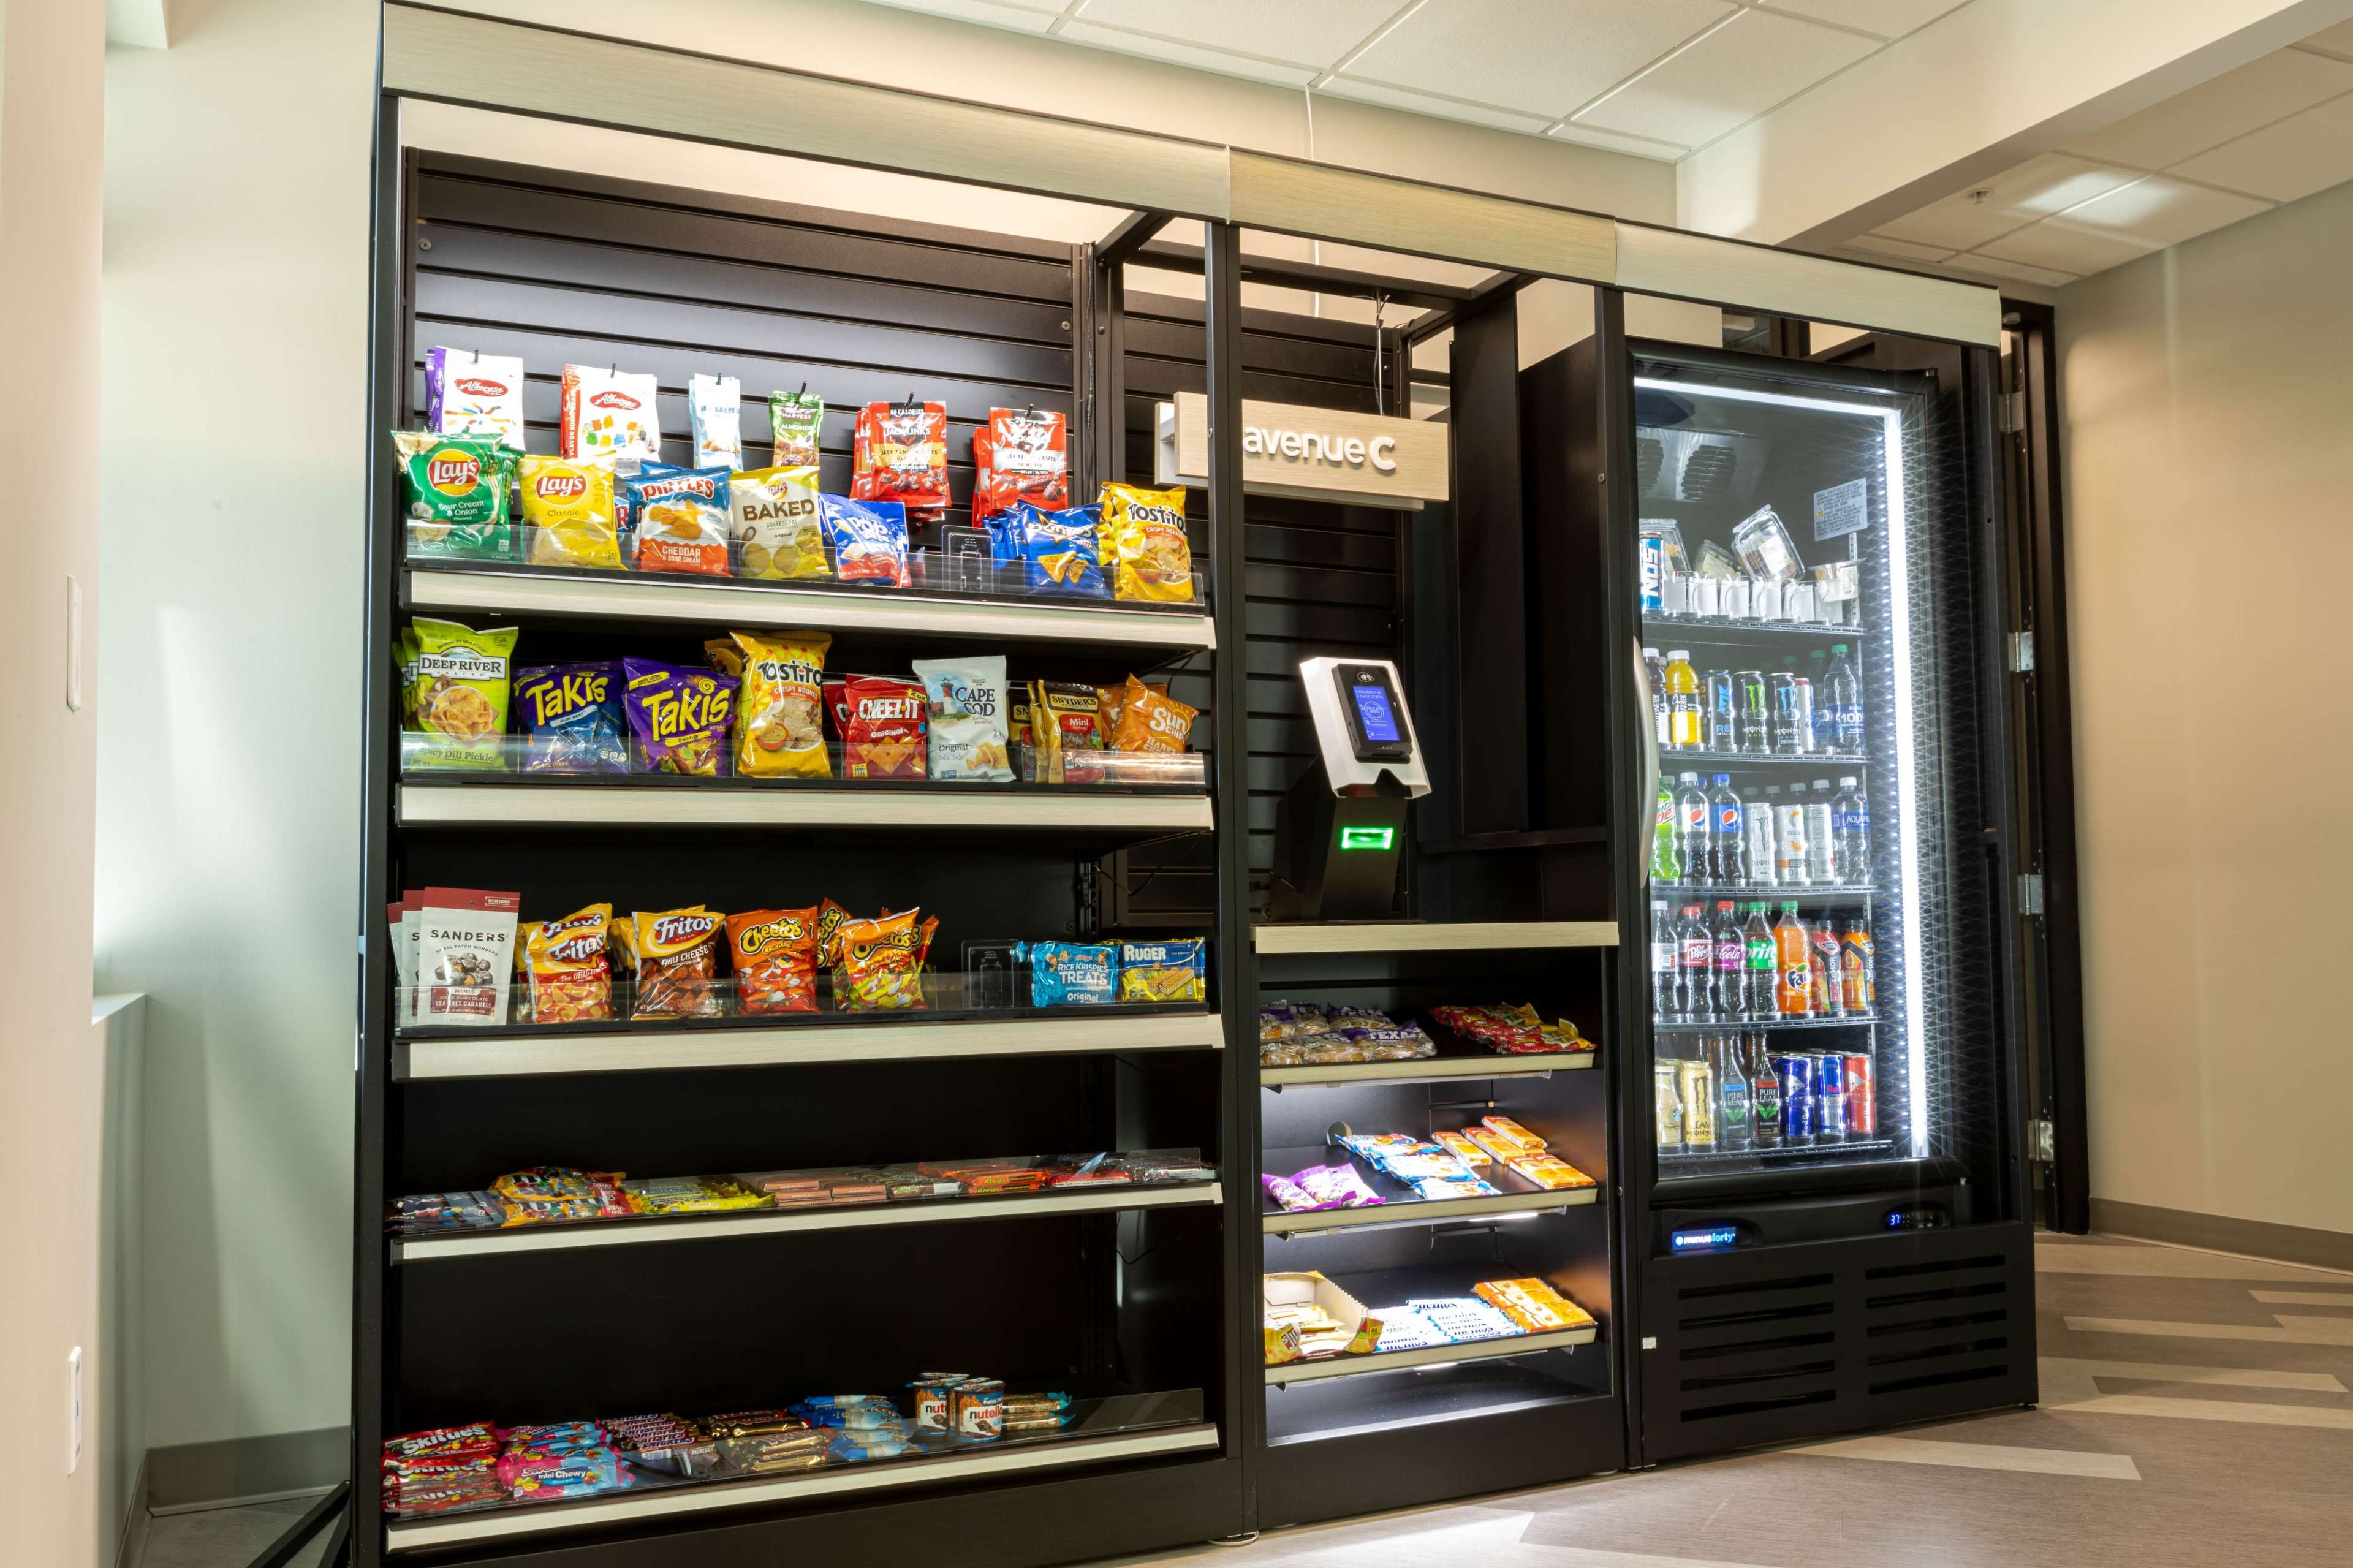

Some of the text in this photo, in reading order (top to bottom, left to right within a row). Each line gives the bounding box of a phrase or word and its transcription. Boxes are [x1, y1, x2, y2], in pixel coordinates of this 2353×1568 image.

[1242, 426, 1398, 471] avenue C
[433, 459, 479, 485] Lay's
[539, 475, 585, 497] Lay's
[438, 500, 484, 510] Sour Cream
[743, 498, 815, 521] BAKED
[455, 508, 478, 517] Onion
[547, 509, 580, 517] Classic
[662, 545, 701, 556] CHEDDAR
[421, 657, 502, 673] DEEP RIVER
[773, 685, 797, 695] CRISPY
[955, 687, 996, 703] CAPE
[525, 675, 609, 726] Takis
[1051, 696, 1097, 706] SNYDER'S
[642, 688, 730, 742] Takis
[963, 703, 995, 716] COD
[1150, 707, 1187, 735] Sun
[445, 749, 462, 759] Dill
[464, 752, 494, 761] Pickle
[938, 744, 969, 753] Original
[431, 929, 506, 942] SANDERS
[653, 915, 713, 945] Fritos
[741, 917, 804, 954] Cheetos
[473, 945, 498, 956] WONDERS
[680, 944, 709, 961] CHEESE
[1124, 944, 1167, 962] RUGER
[1058, 962, 1109, 974] RICE KRISPIES
[1059, 971, 1107, 985] TREATS
[1067, 992, 1099, 1003] Original
[1694, 1121, 1710, 1129] JAV
[538, 1471, 555, 1480] mini
[555, 1470, 586, 1482] Chewy
